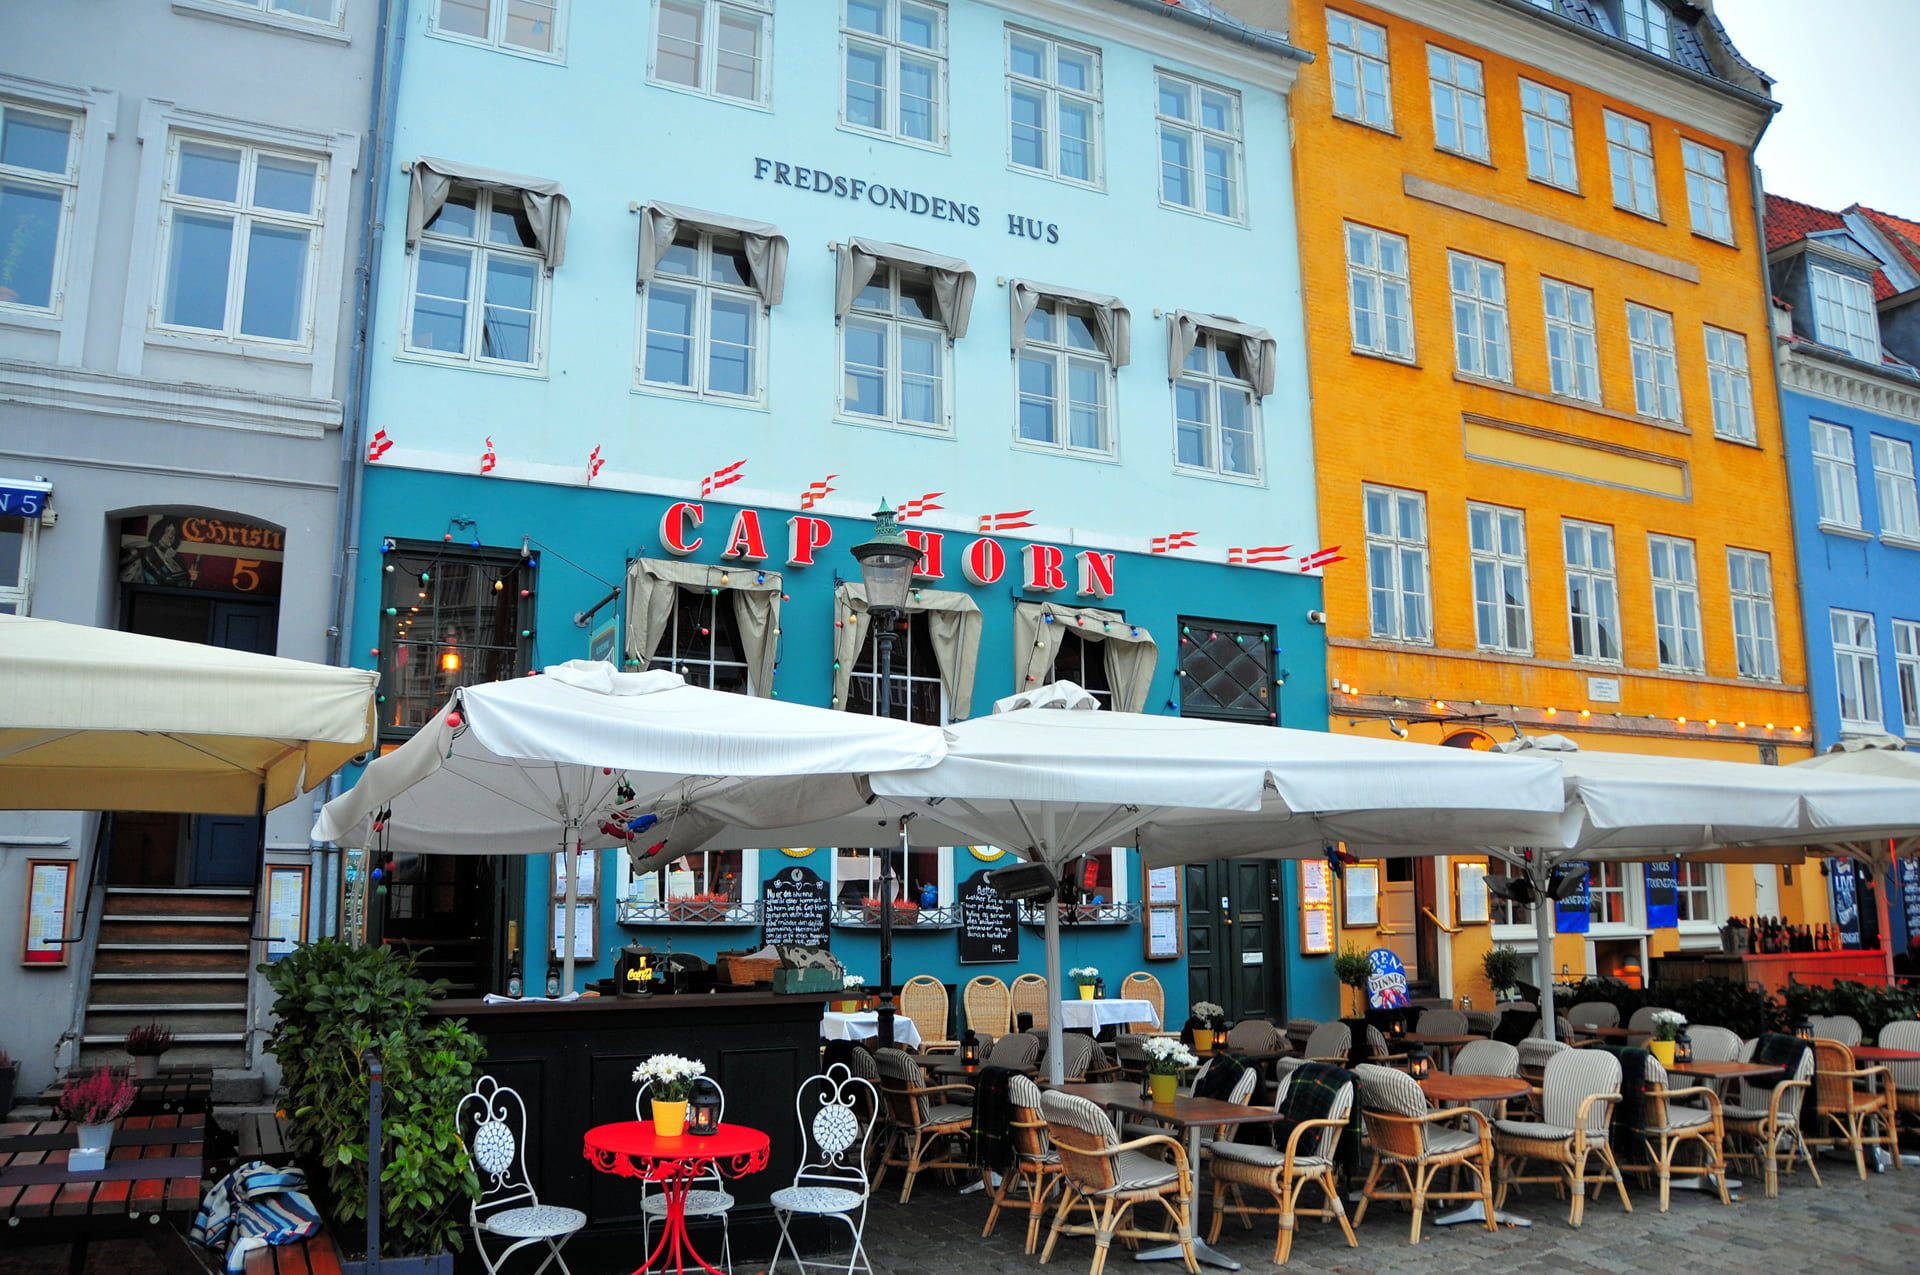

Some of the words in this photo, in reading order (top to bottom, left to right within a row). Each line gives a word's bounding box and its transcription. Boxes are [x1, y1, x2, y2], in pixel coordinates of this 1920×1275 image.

[754, 157, 981, 227] FREDSFONDENS
[1007, 213, 1060, 245] HUS
[20, 495, 38, 514] 5
[660, 502, 833, 567] CAP
[901, 530, 1116, 598] HORN
[231, 558, 261, 593] 5
[1834, 876, 1856, 892] LIVE
[1371, 973, 1406, 991] DINNER
